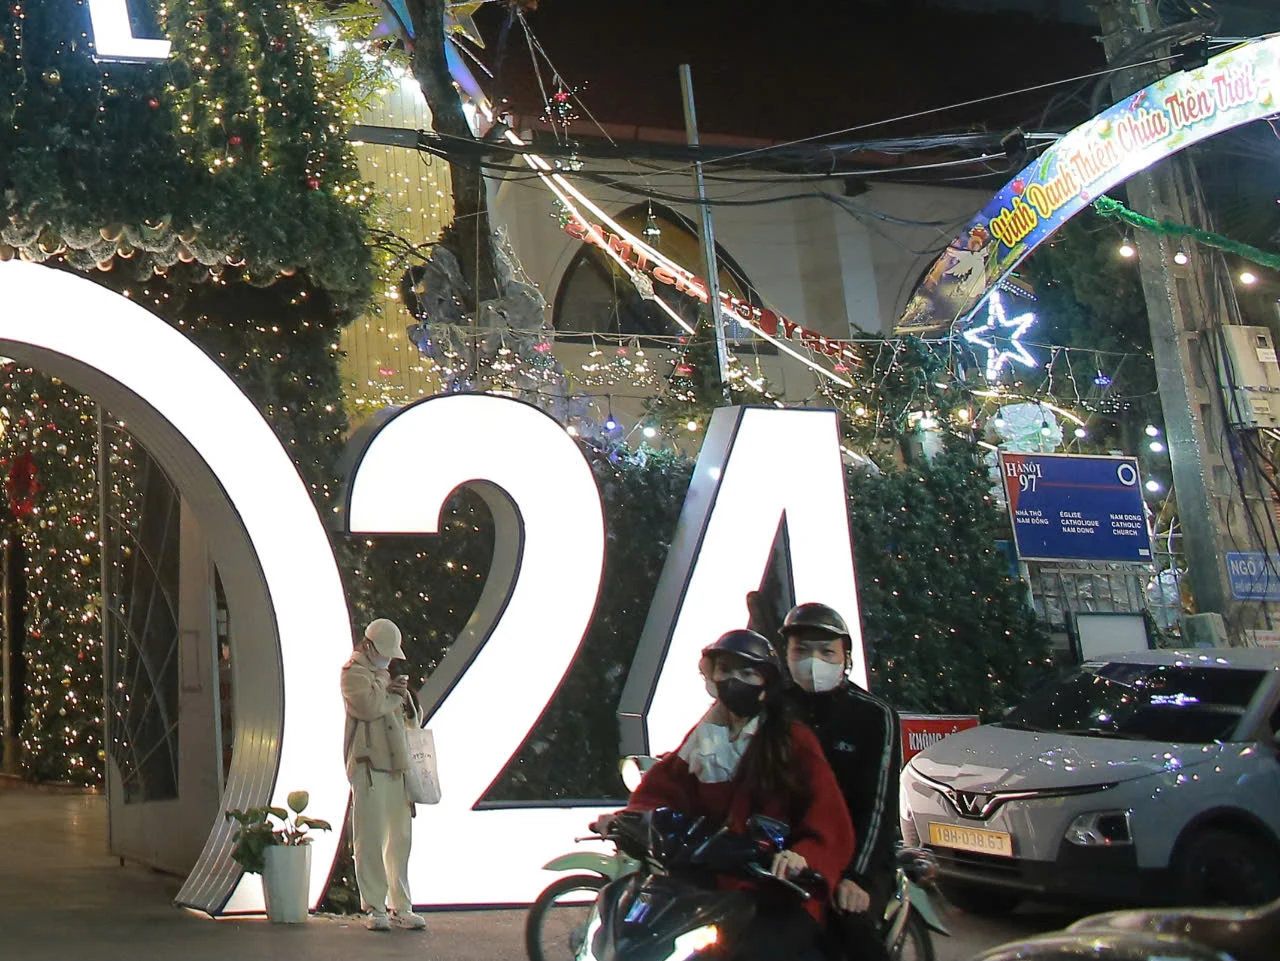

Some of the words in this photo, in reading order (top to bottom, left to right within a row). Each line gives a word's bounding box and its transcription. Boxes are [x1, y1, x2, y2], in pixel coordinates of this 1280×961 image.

[991, 197, 1037, 247] Vinh
[1027, 164, 1078, 218] Danh
[1165, 90, 1212, 128] Trên
[1019, 474, 1036, 492] 97
[1059, 510, 1082, 518] ÉGLISE
[1060, 519, 1100, 527] CATHOLIQUE
[1111, 521, 1141, 529] CATHOLIC
